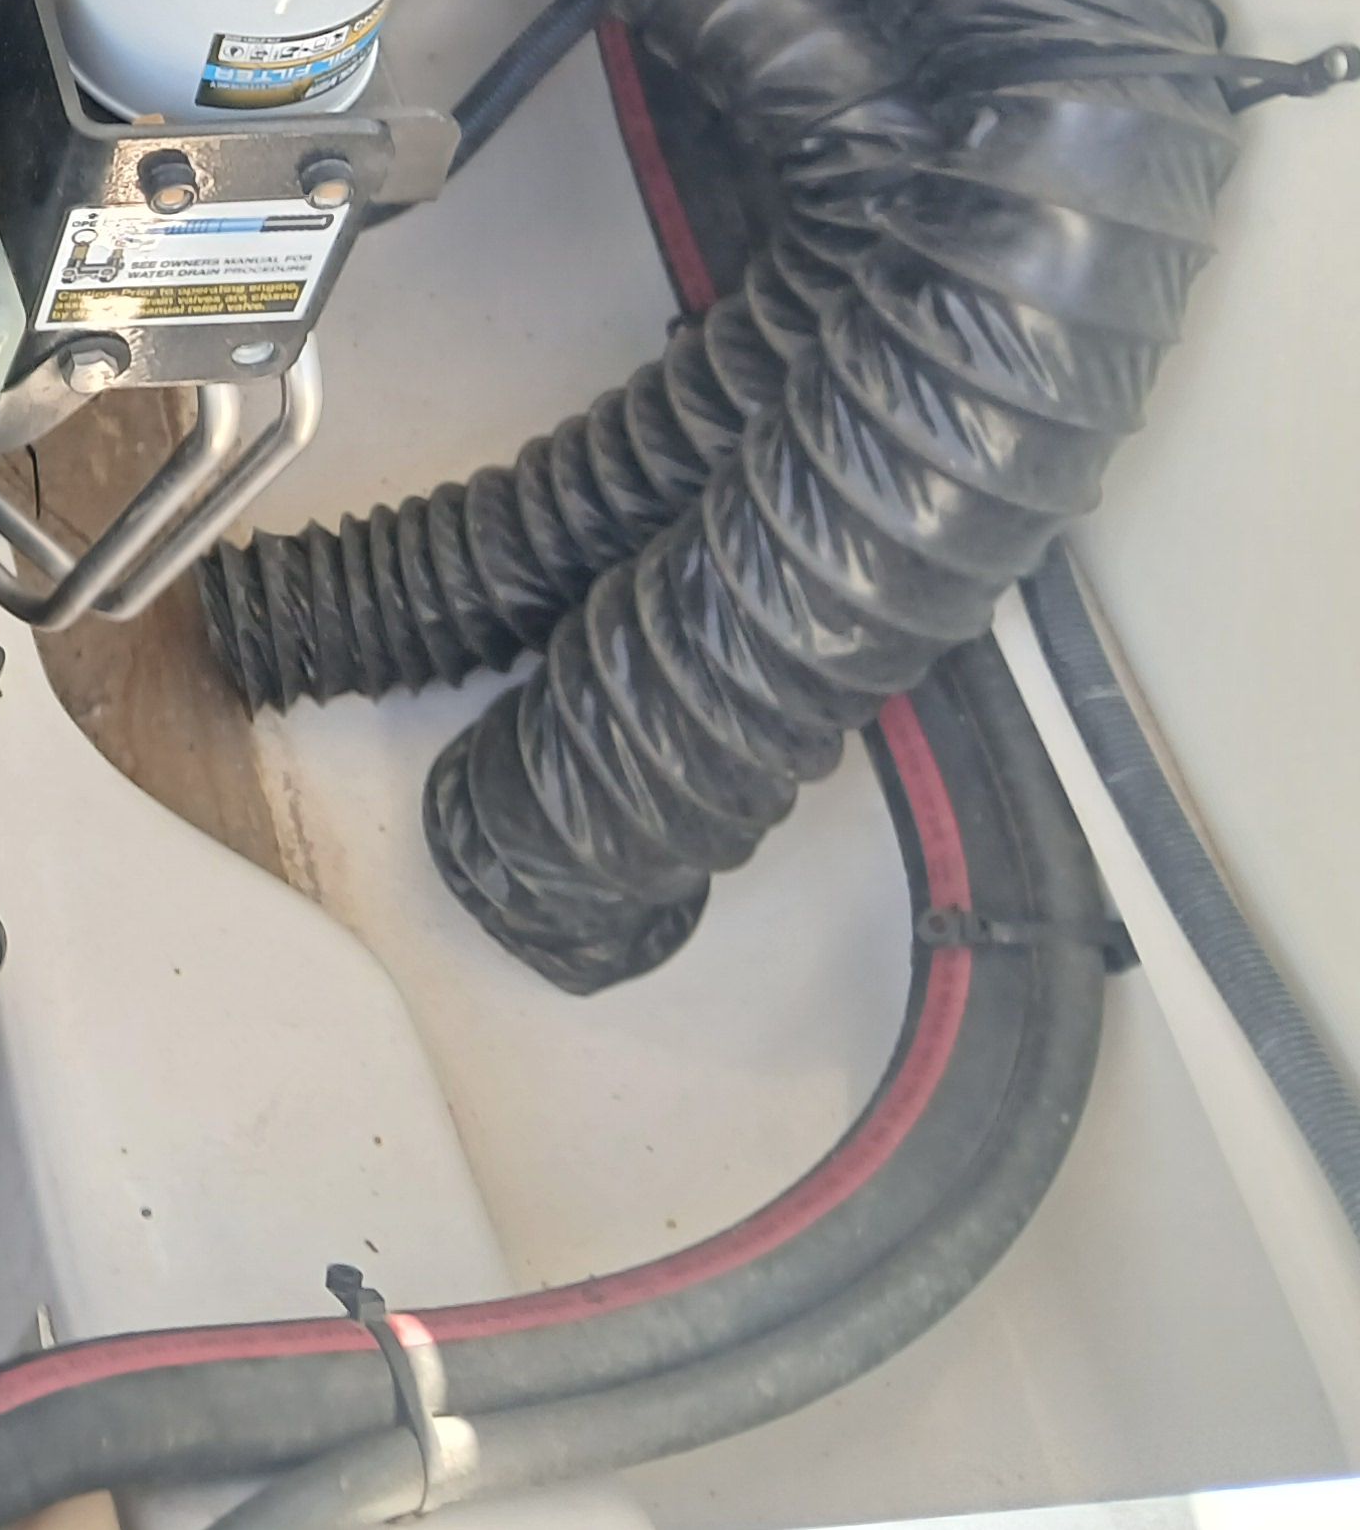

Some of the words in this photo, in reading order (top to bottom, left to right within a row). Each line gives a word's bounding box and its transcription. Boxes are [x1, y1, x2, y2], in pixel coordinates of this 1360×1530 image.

[72, 220, 98, 228] OPE
[128, 269, 174, 278] WATER
[177, 268, 220, 277] DRAIN
